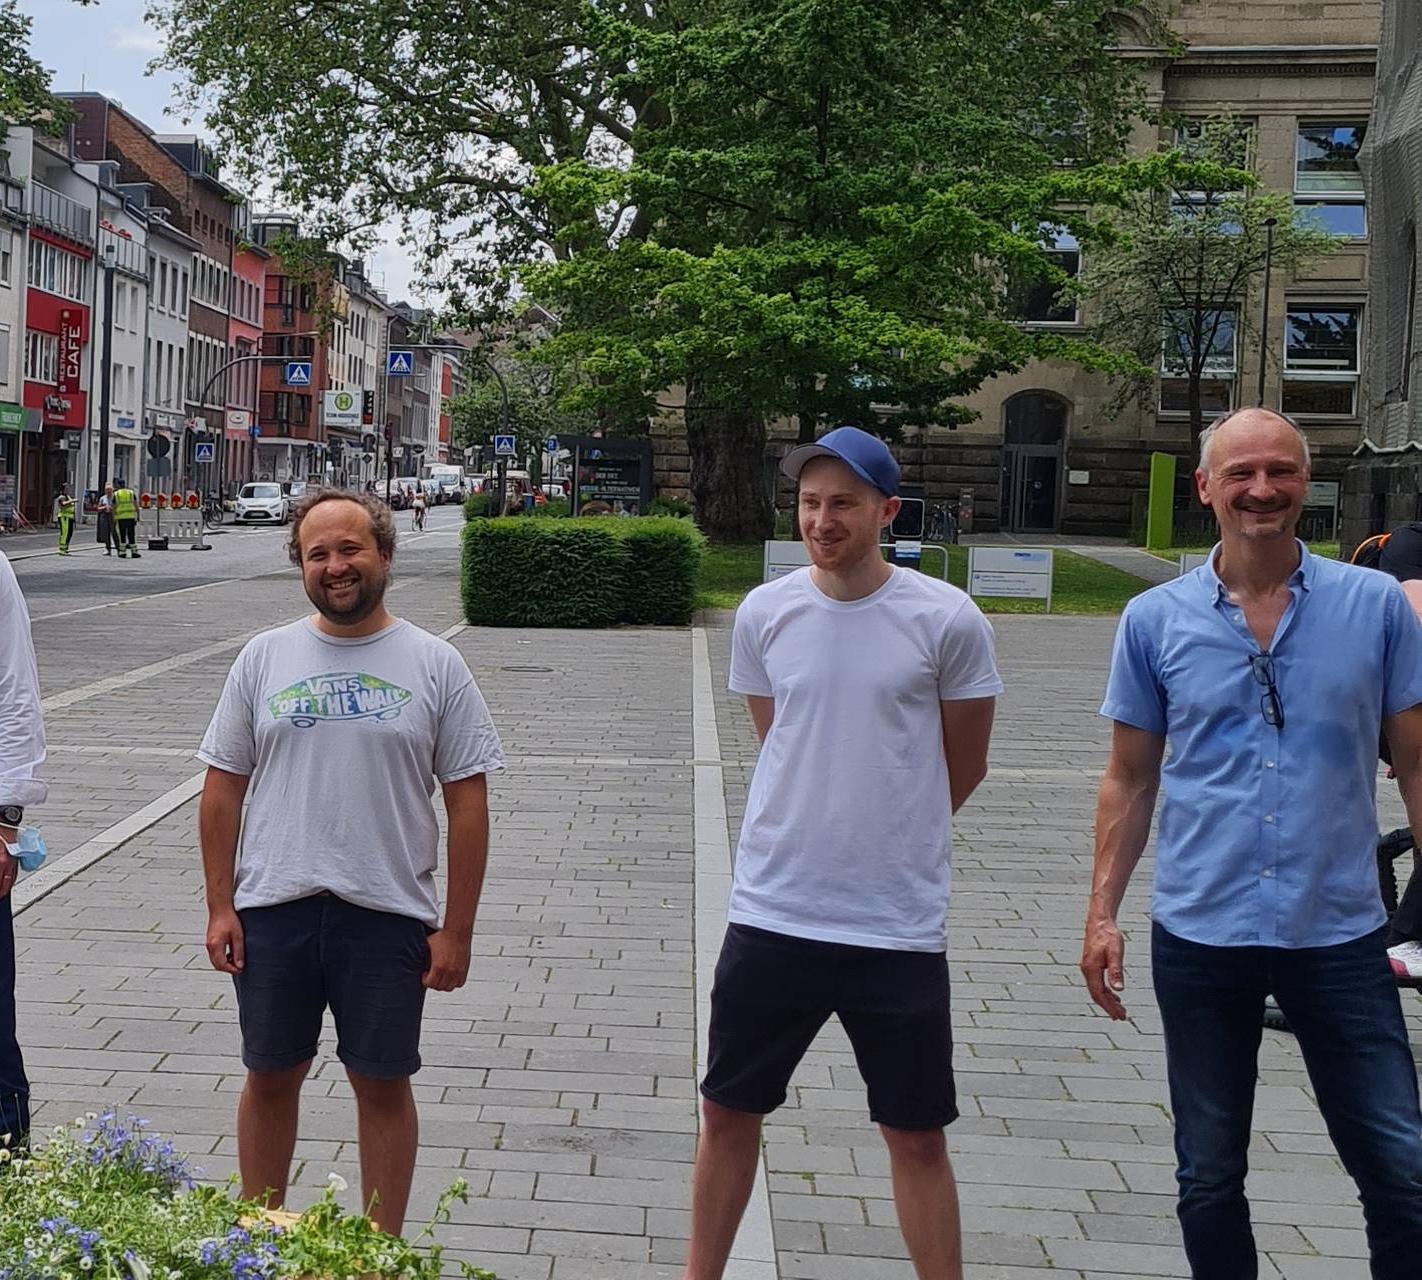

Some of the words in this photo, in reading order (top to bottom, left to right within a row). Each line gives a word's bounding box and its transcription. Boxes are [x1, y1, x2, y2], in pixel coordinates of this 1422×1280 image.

[59, 322, 69, 382] RESTAURANT
[67, 325, 81, 378] CAFE
[305, 674, 361, 695] VANS
[315, 692, 354, 715] THE
